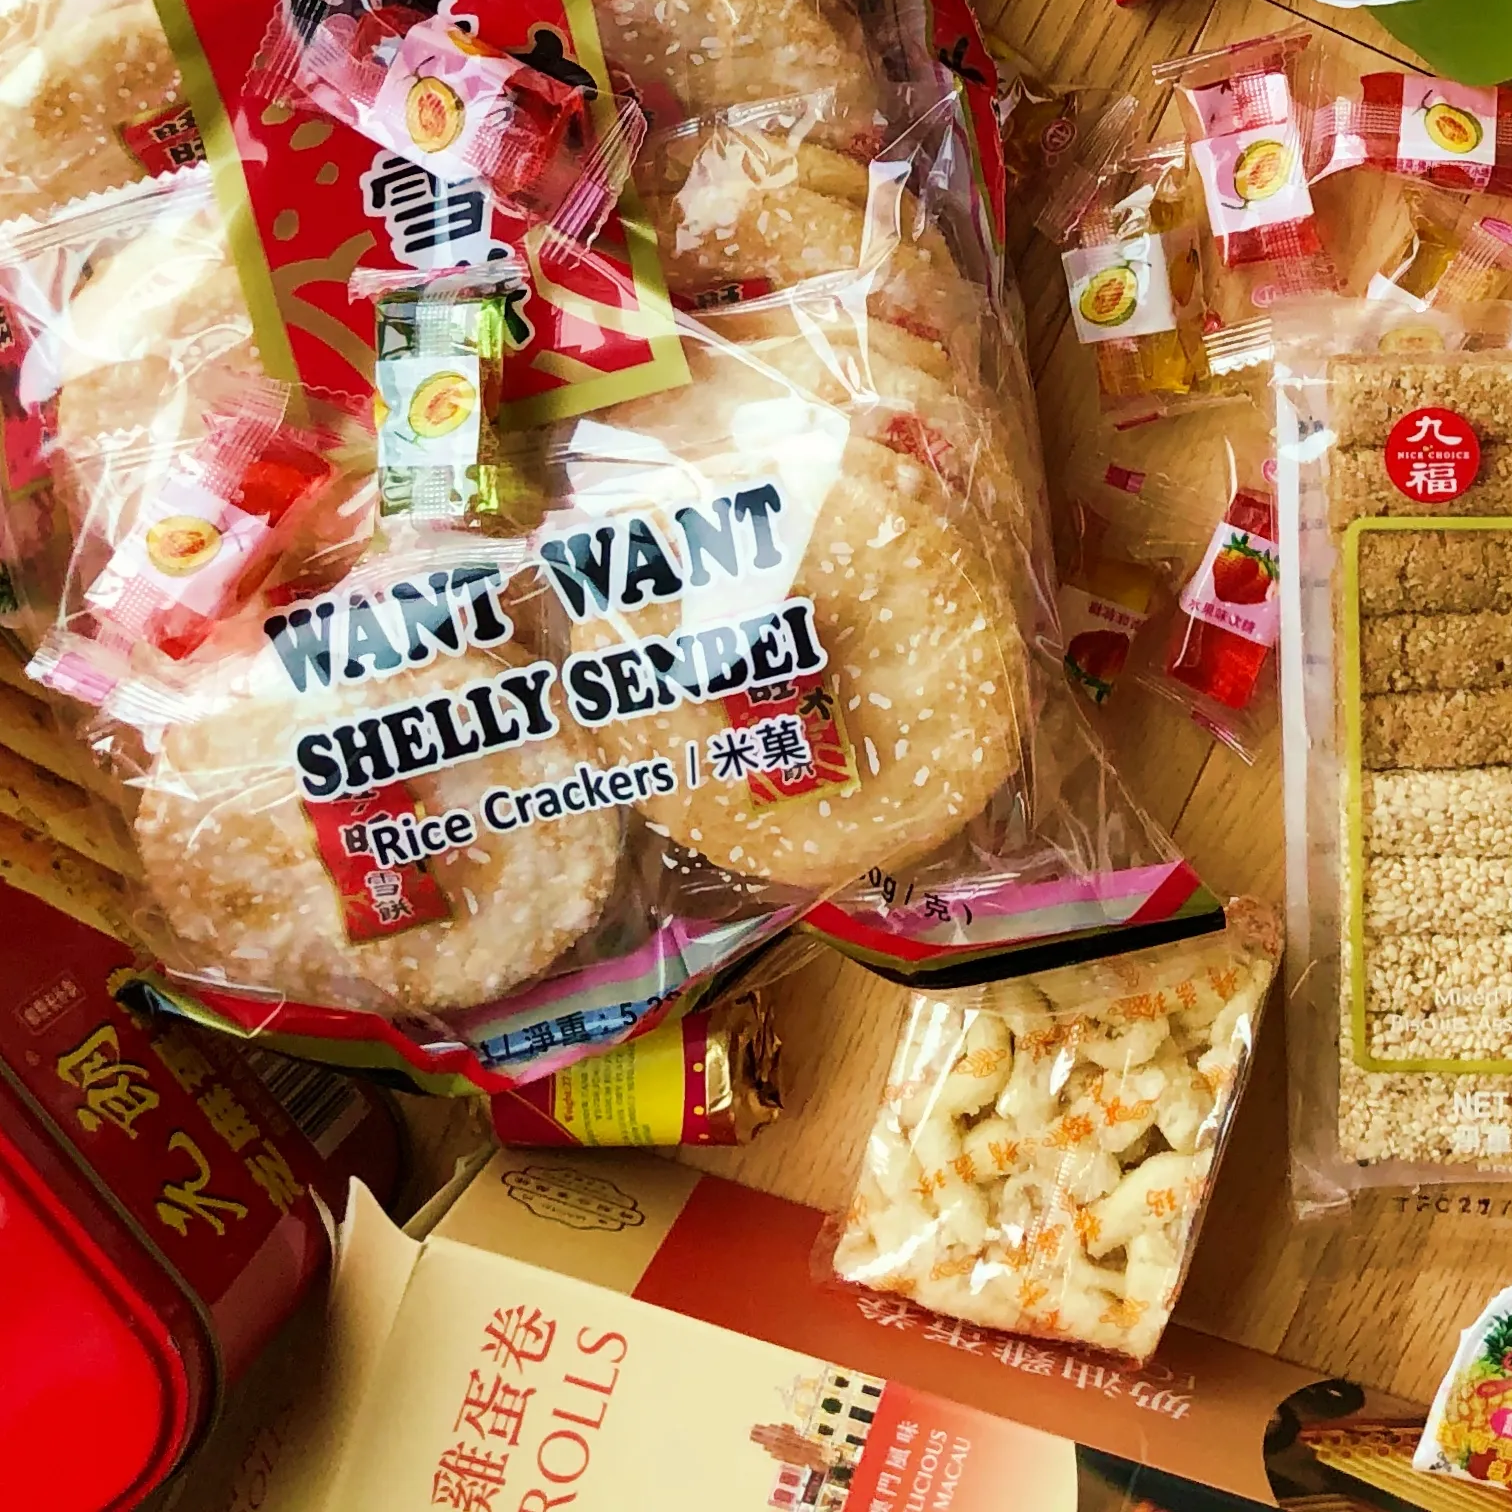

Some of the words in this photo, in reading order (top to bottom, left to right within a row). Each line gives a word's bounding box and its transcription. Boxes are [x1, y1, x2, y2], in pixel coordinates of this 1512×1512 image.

[1406, 416, 1463, 445] 九
[1428, 451, 1470, 460] CHOICE
[1405, 462, 1458, 495] 福
[265, 568, 502, 693] WANT
[541, 484, 783, 618] WANT
[301, 668, 554, 797] SHELLY
[568, 605, 822, 721] SENBEI
[373, 811, 474, 866] Rice
[484, 758, 675, 831] Crackers
[713, 719, 811, 776] 米菓
[859, 866, 896, 903] 0g
[1434, 986, 1498, 1006] Mixed
[1452, 1090, 1509, 1119] NET
[430, 1303, 557, 1512] 雞蛋卷
[516, 1326, 628, 1512] ROLLS
[933, 1436, 973, 1512] MACAU
